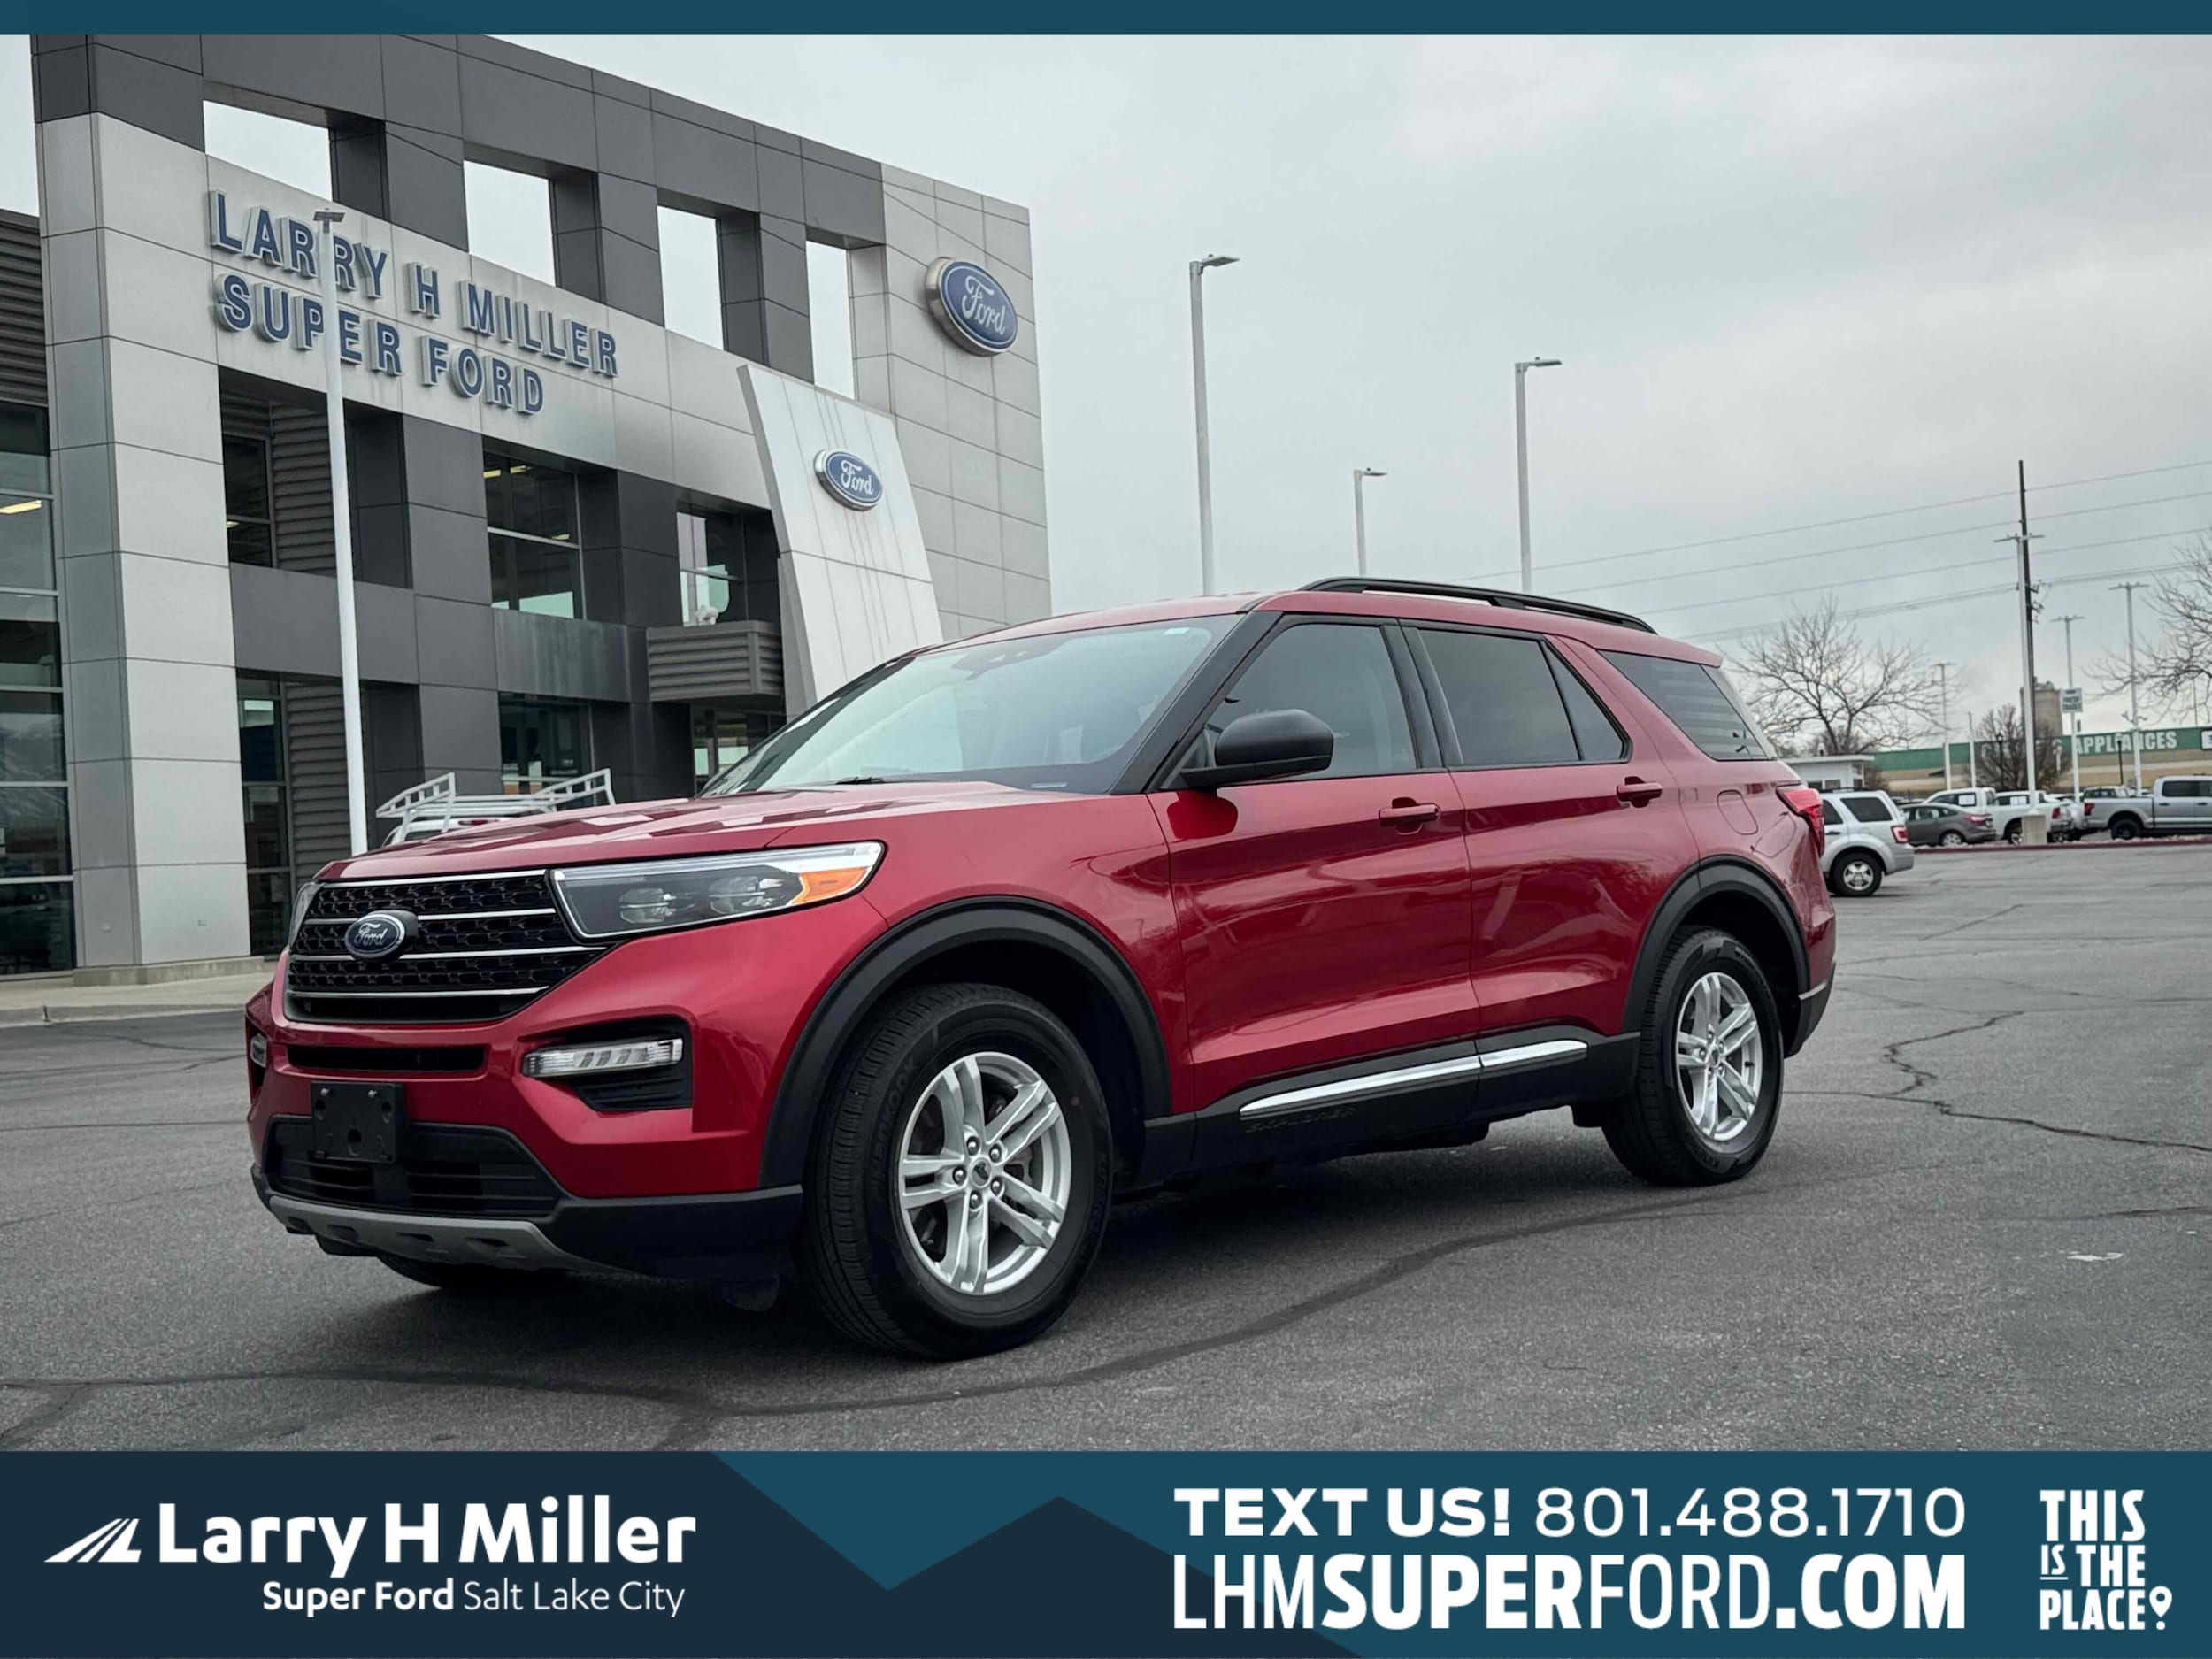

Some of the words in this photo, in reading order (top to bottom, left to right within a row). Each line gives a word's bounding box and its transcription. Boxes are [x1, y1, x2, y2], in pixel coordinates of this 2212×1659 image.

[210, 189, 389, 300] LARRY
[407, 261, 442, 319] H
[460, 279, 618, 378] MILLER
[961, 275, 1006, 336] Ford
[215, 273, 403, 377] SUPER
[421, 334, 545, 416] FORD
[841, 459, 874, 495] Ford
[354, 922, 388, 947] Ford
